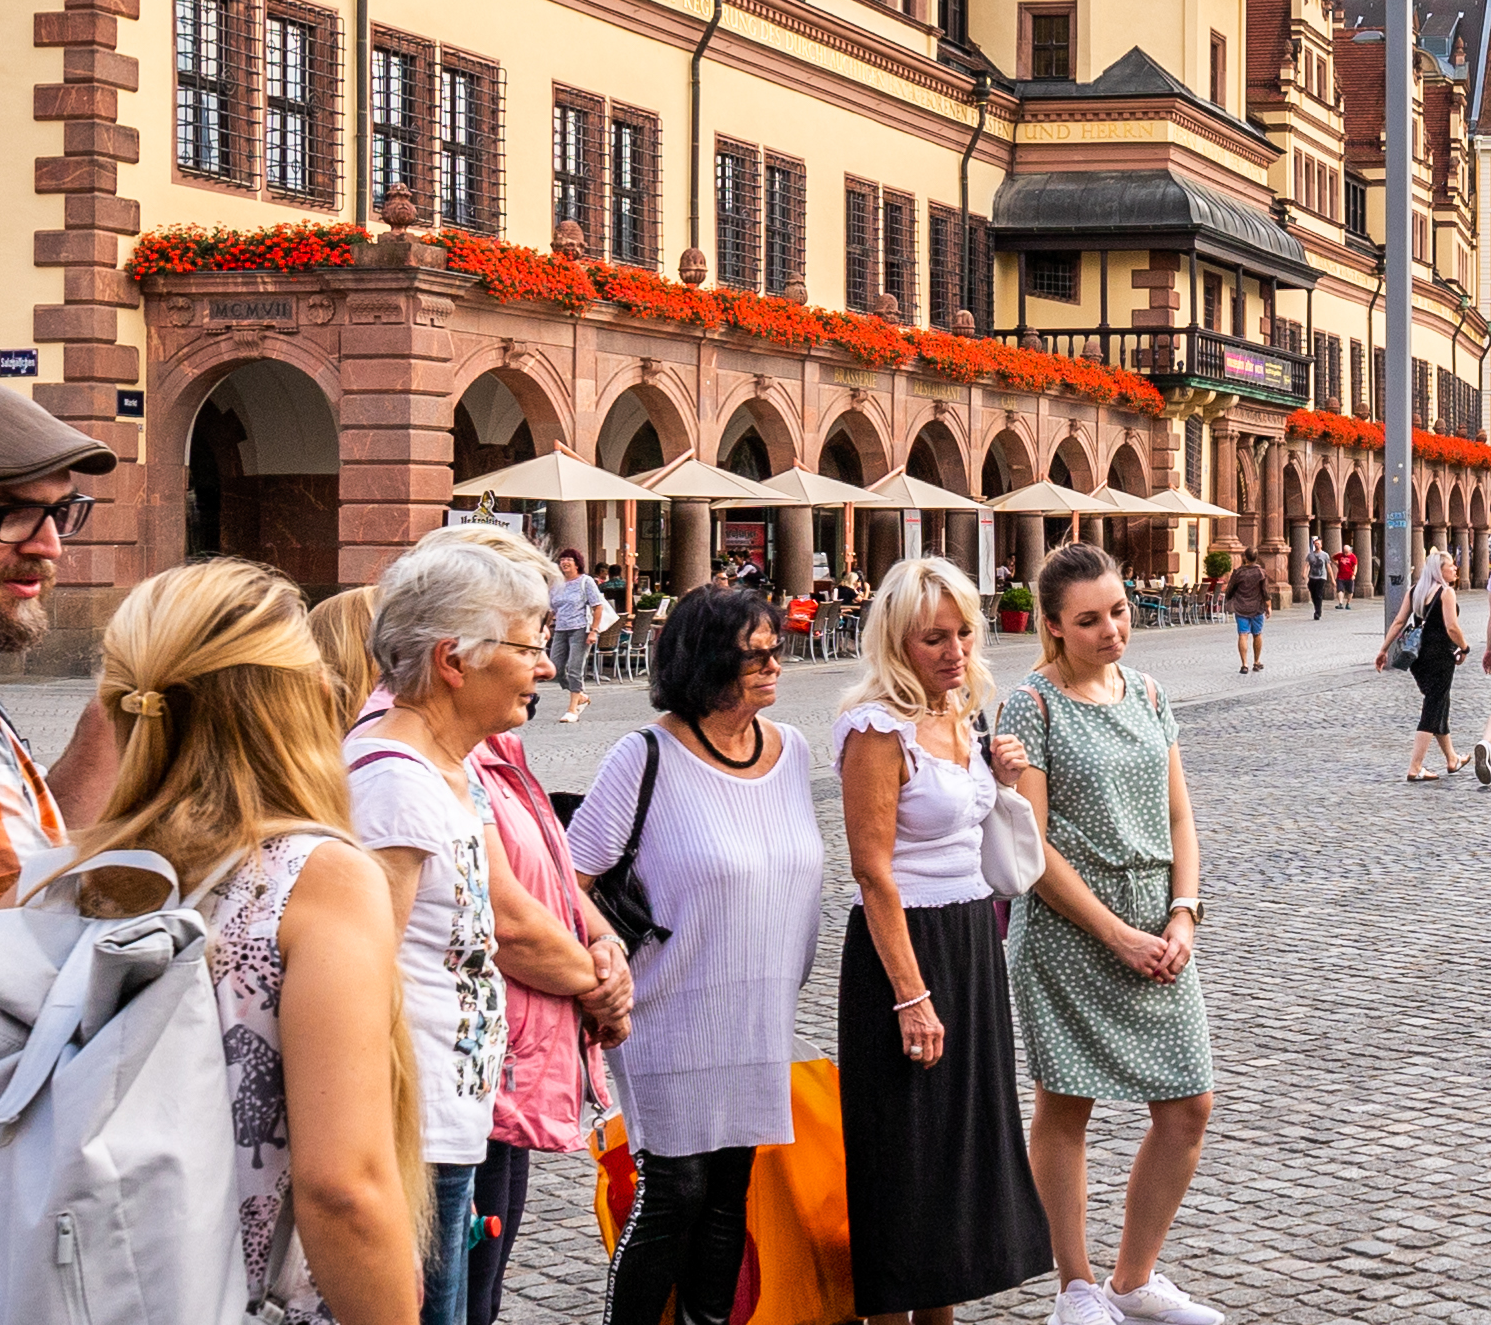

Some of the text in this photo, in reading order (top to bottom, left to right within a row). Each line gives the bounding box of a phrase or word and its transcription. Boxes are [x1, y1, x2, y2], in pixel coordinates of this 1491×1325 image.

[760, 20, 781, 46] DES
[1024, 124, 1071, 140] UND
[1081, 122, 1154, 140] HERRN
[833, 367, 877, 388] BRASSERIE
